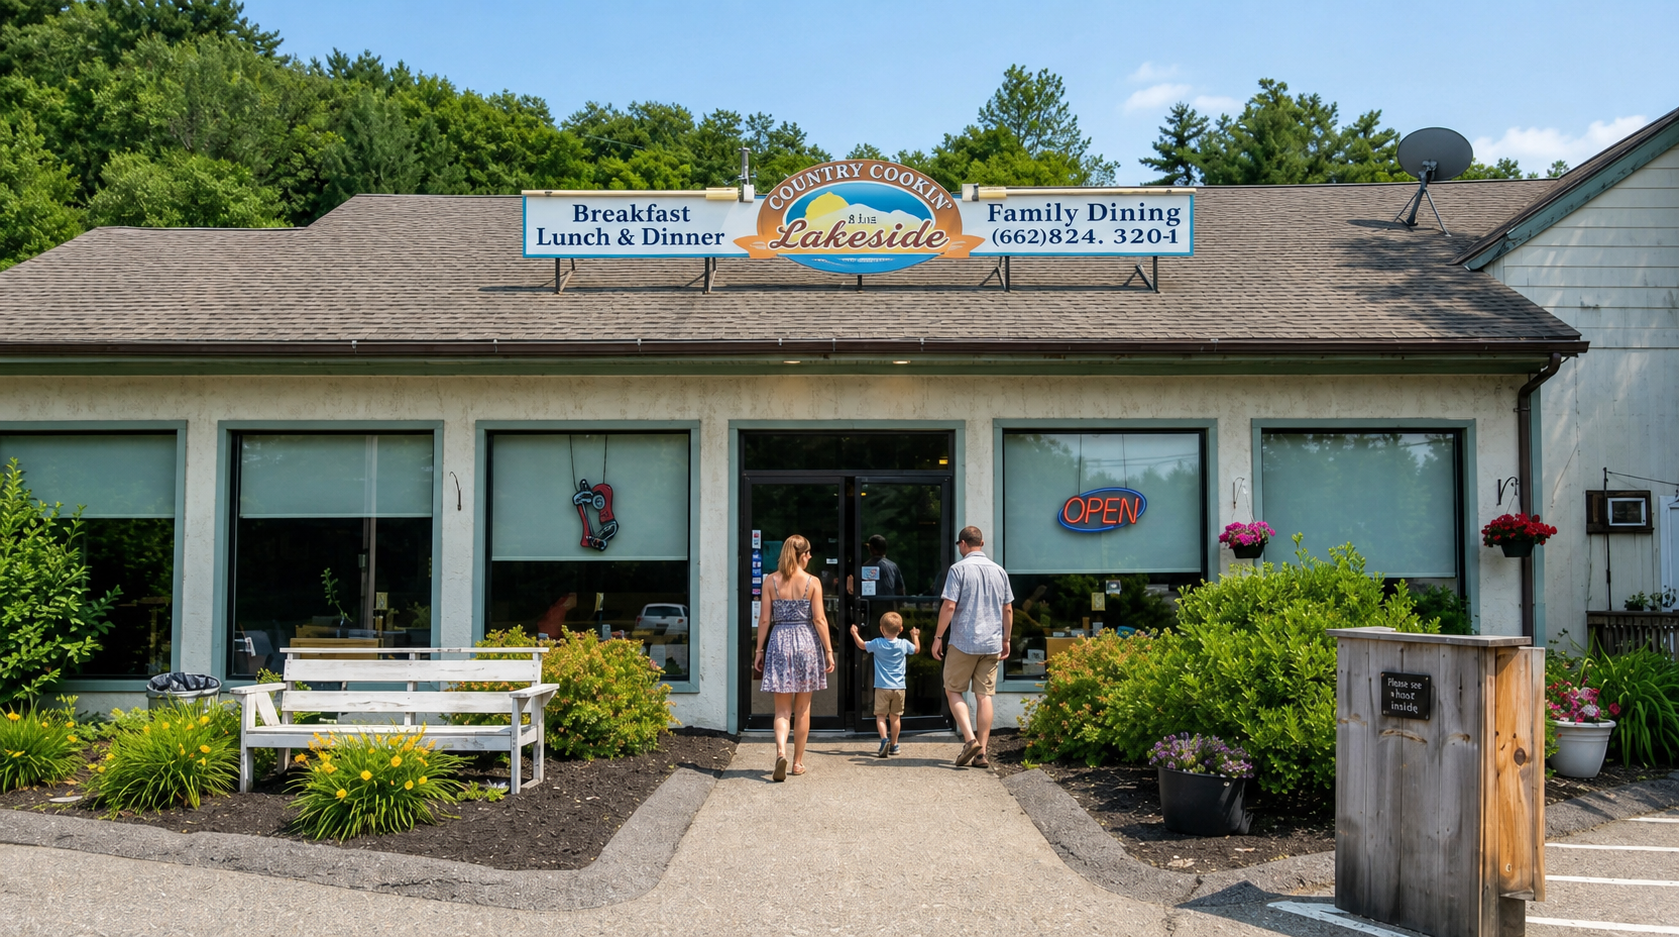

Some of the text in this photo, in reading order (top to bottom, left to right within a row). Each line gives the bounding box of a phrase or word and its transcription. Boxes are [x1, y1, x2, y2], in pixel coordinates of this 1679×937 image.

[769, 163, 864, 211] COUNTRY
[572, 204, 691, 223] Breakfast
[987, 202, 1182, 227] Family Dining
[536, 227, 726, 246] Lunch & Dinner
[769, 219, 950, 250] Lakeside
[1063, 496, 1140, 525] OPEN
